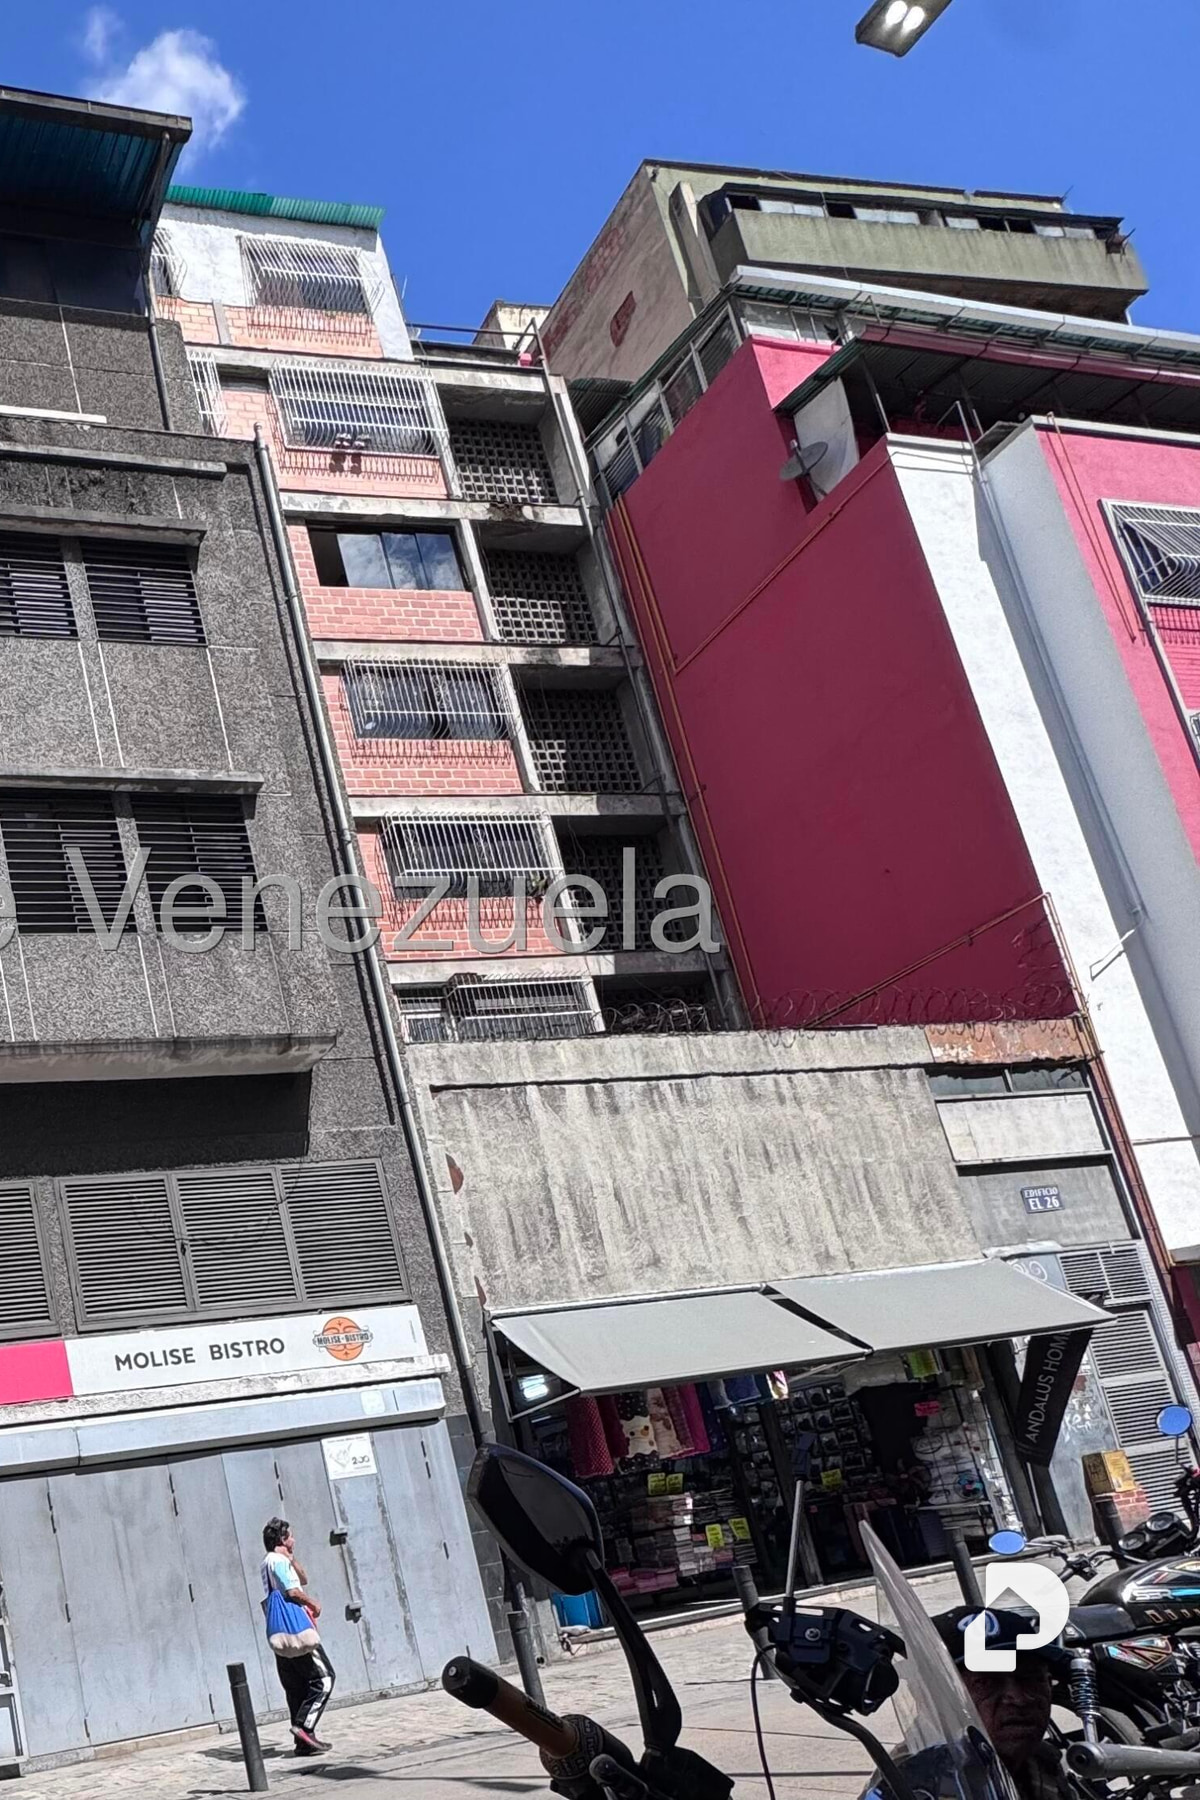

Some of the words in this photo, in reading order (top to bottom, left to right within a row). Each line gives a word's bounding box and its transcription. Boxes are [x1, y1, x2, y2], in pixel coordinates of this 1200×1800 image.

[1024, 1187, 1058, 1198] EDIFICIO
[1028, 1198, 1044, 1210] EL
[1044, 1196, 1060, 1209] 26
[317, 1335, 341, 1345] MOLISE
[345, 1332, 370, 1342] BISTRO
[115, 1347, 196, 1371] MOLISE
[209, 1337, 285, 1361] BISTRO
[1025, 1374, 1055, 1443] ANDALUS
